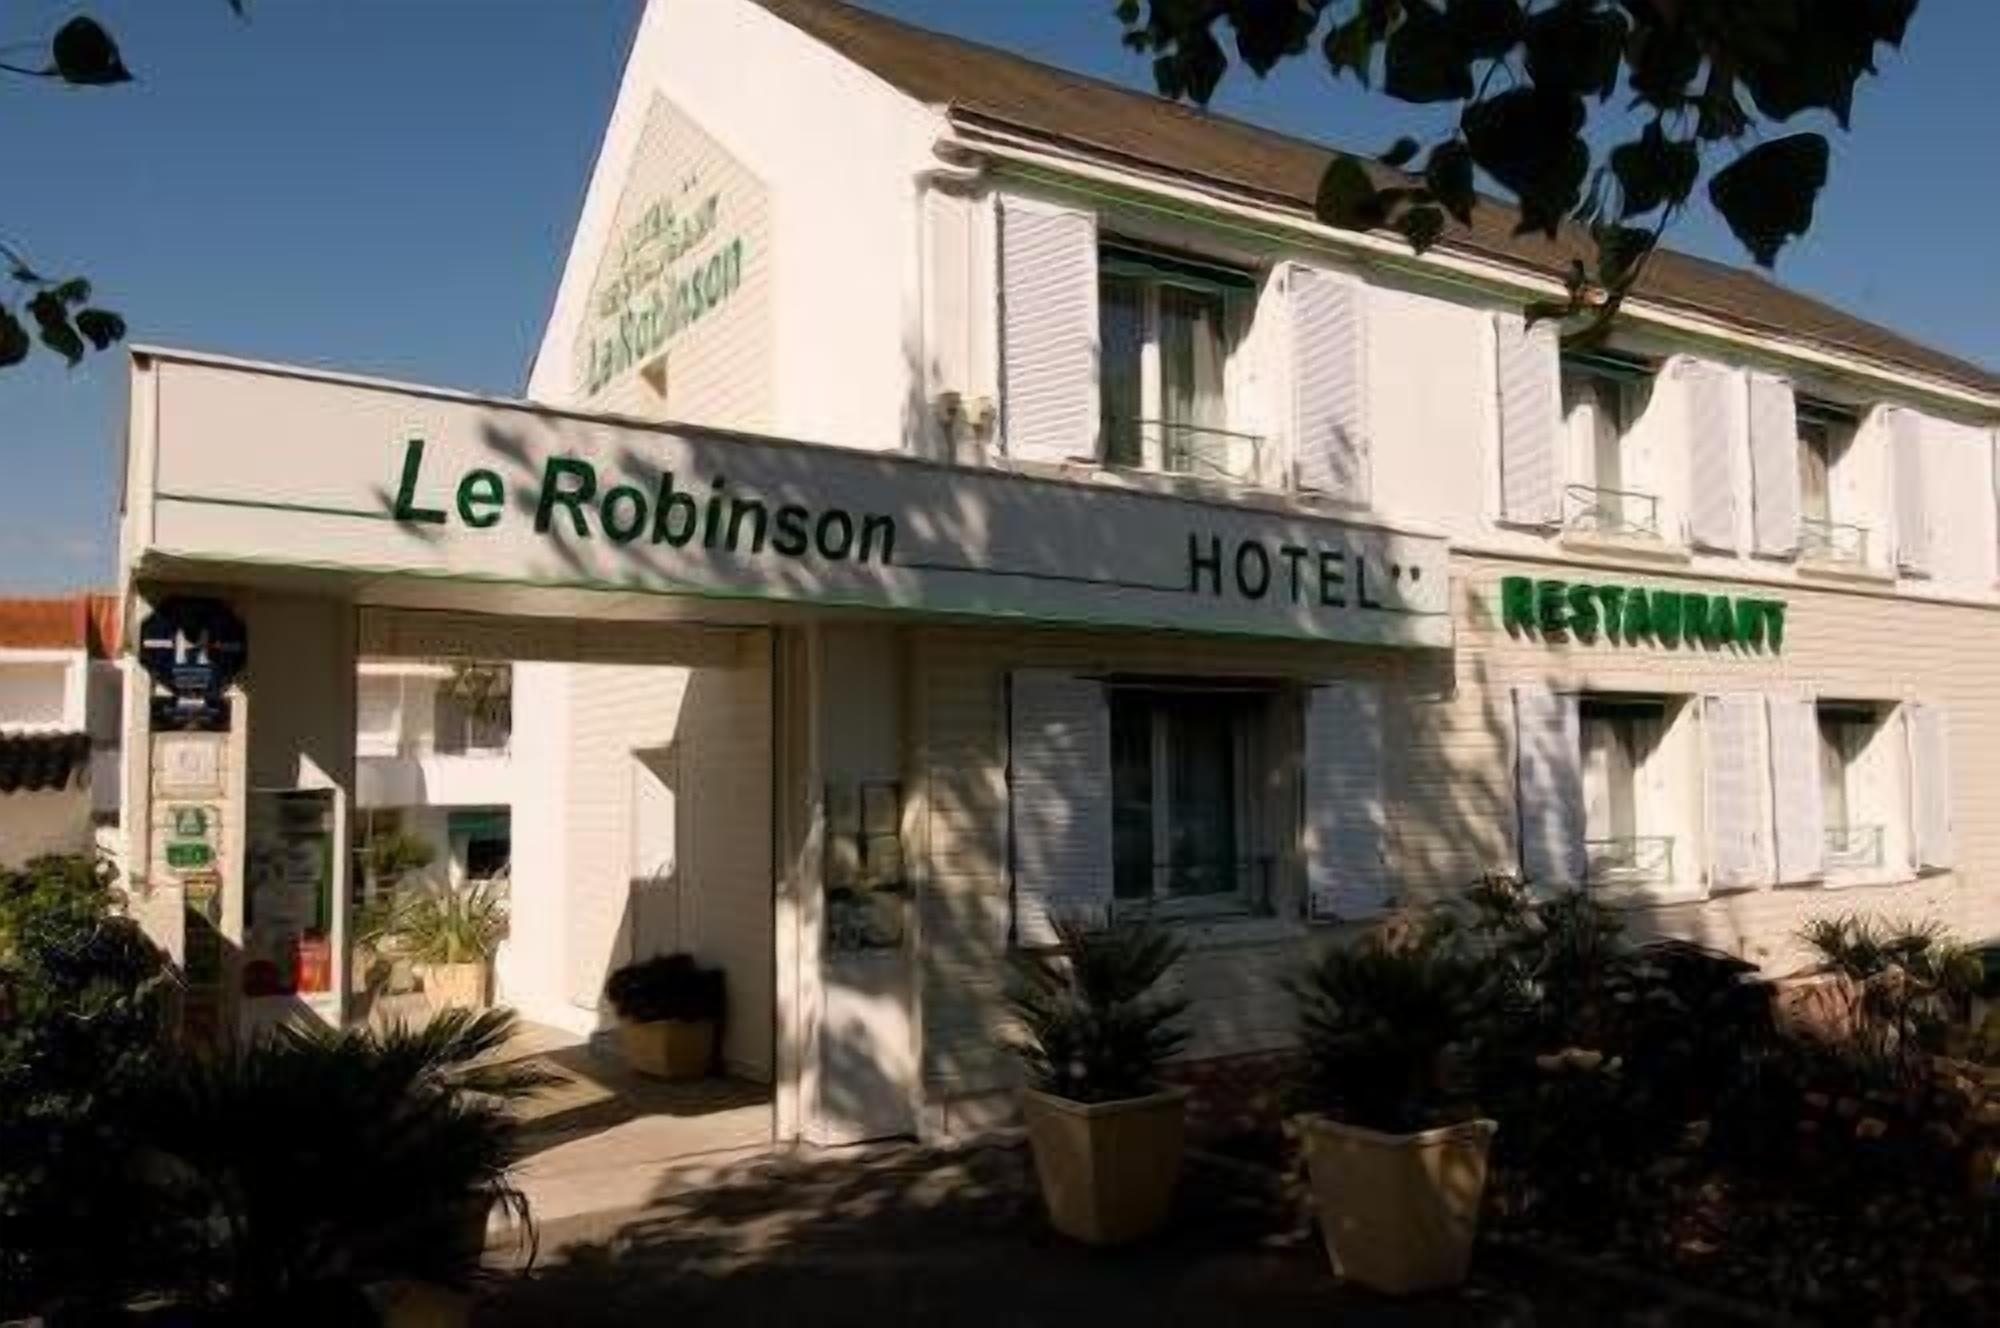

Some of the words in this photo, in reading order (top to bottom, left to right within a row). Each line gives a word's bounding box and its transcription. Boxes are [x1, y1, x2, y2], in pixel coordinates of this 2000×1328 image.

[395, 438, 504, 529] Le
[534, 455, 896, 565] Robinson
[1187, 530, 1382, 609] HOTEL
[1500, 575, 1788, 654] RESTAURANT
